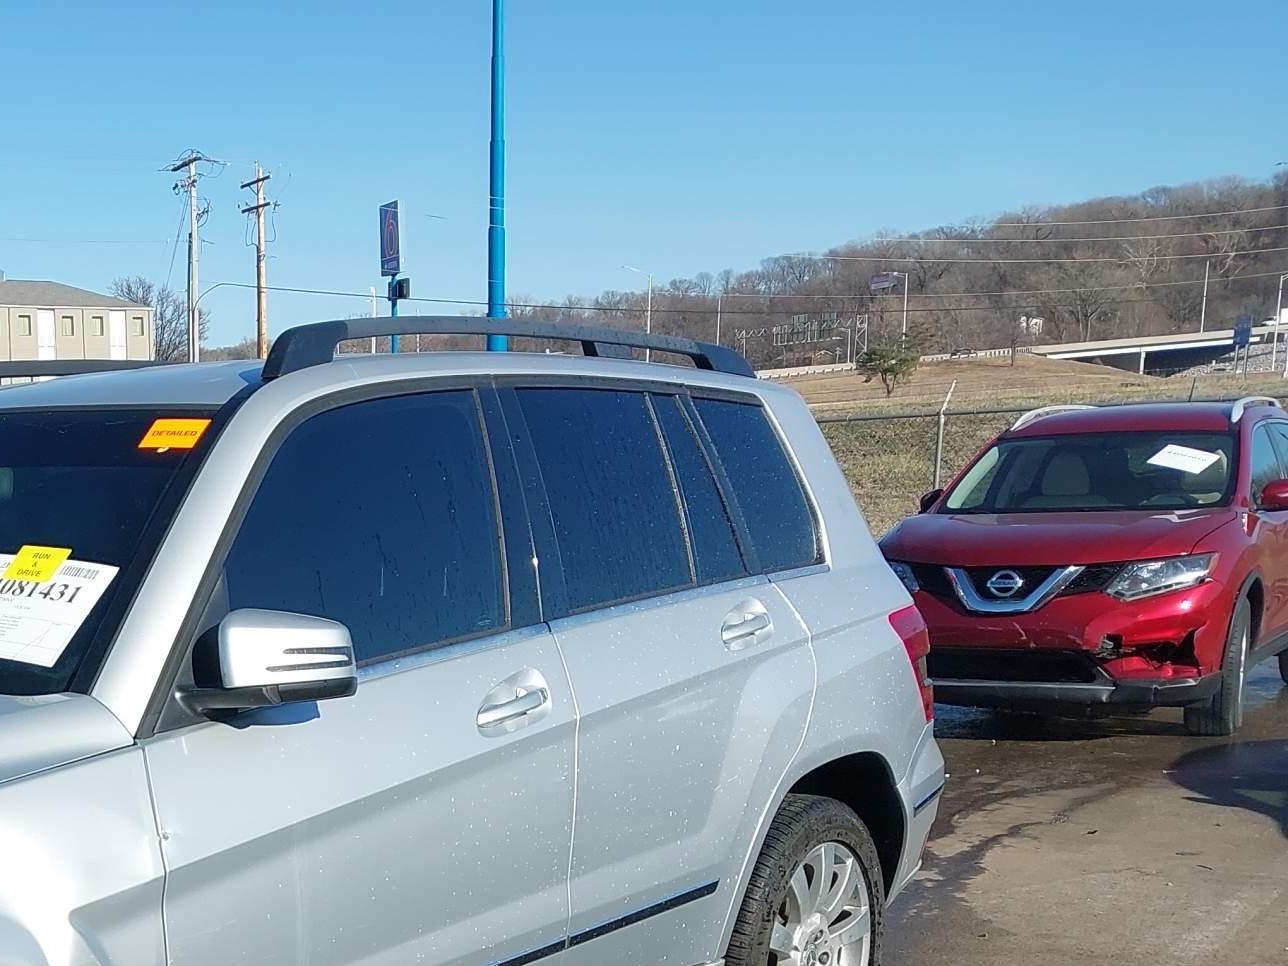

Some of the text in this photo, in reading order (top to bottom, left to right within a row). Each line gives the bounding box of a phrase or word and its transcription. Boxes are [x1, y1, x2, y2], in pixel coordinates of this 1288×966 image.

[151, 429, 198, 437] DETAILED
[32, 552, 51, 560] RUN
[16, 569, 42, 577] DRIVE
